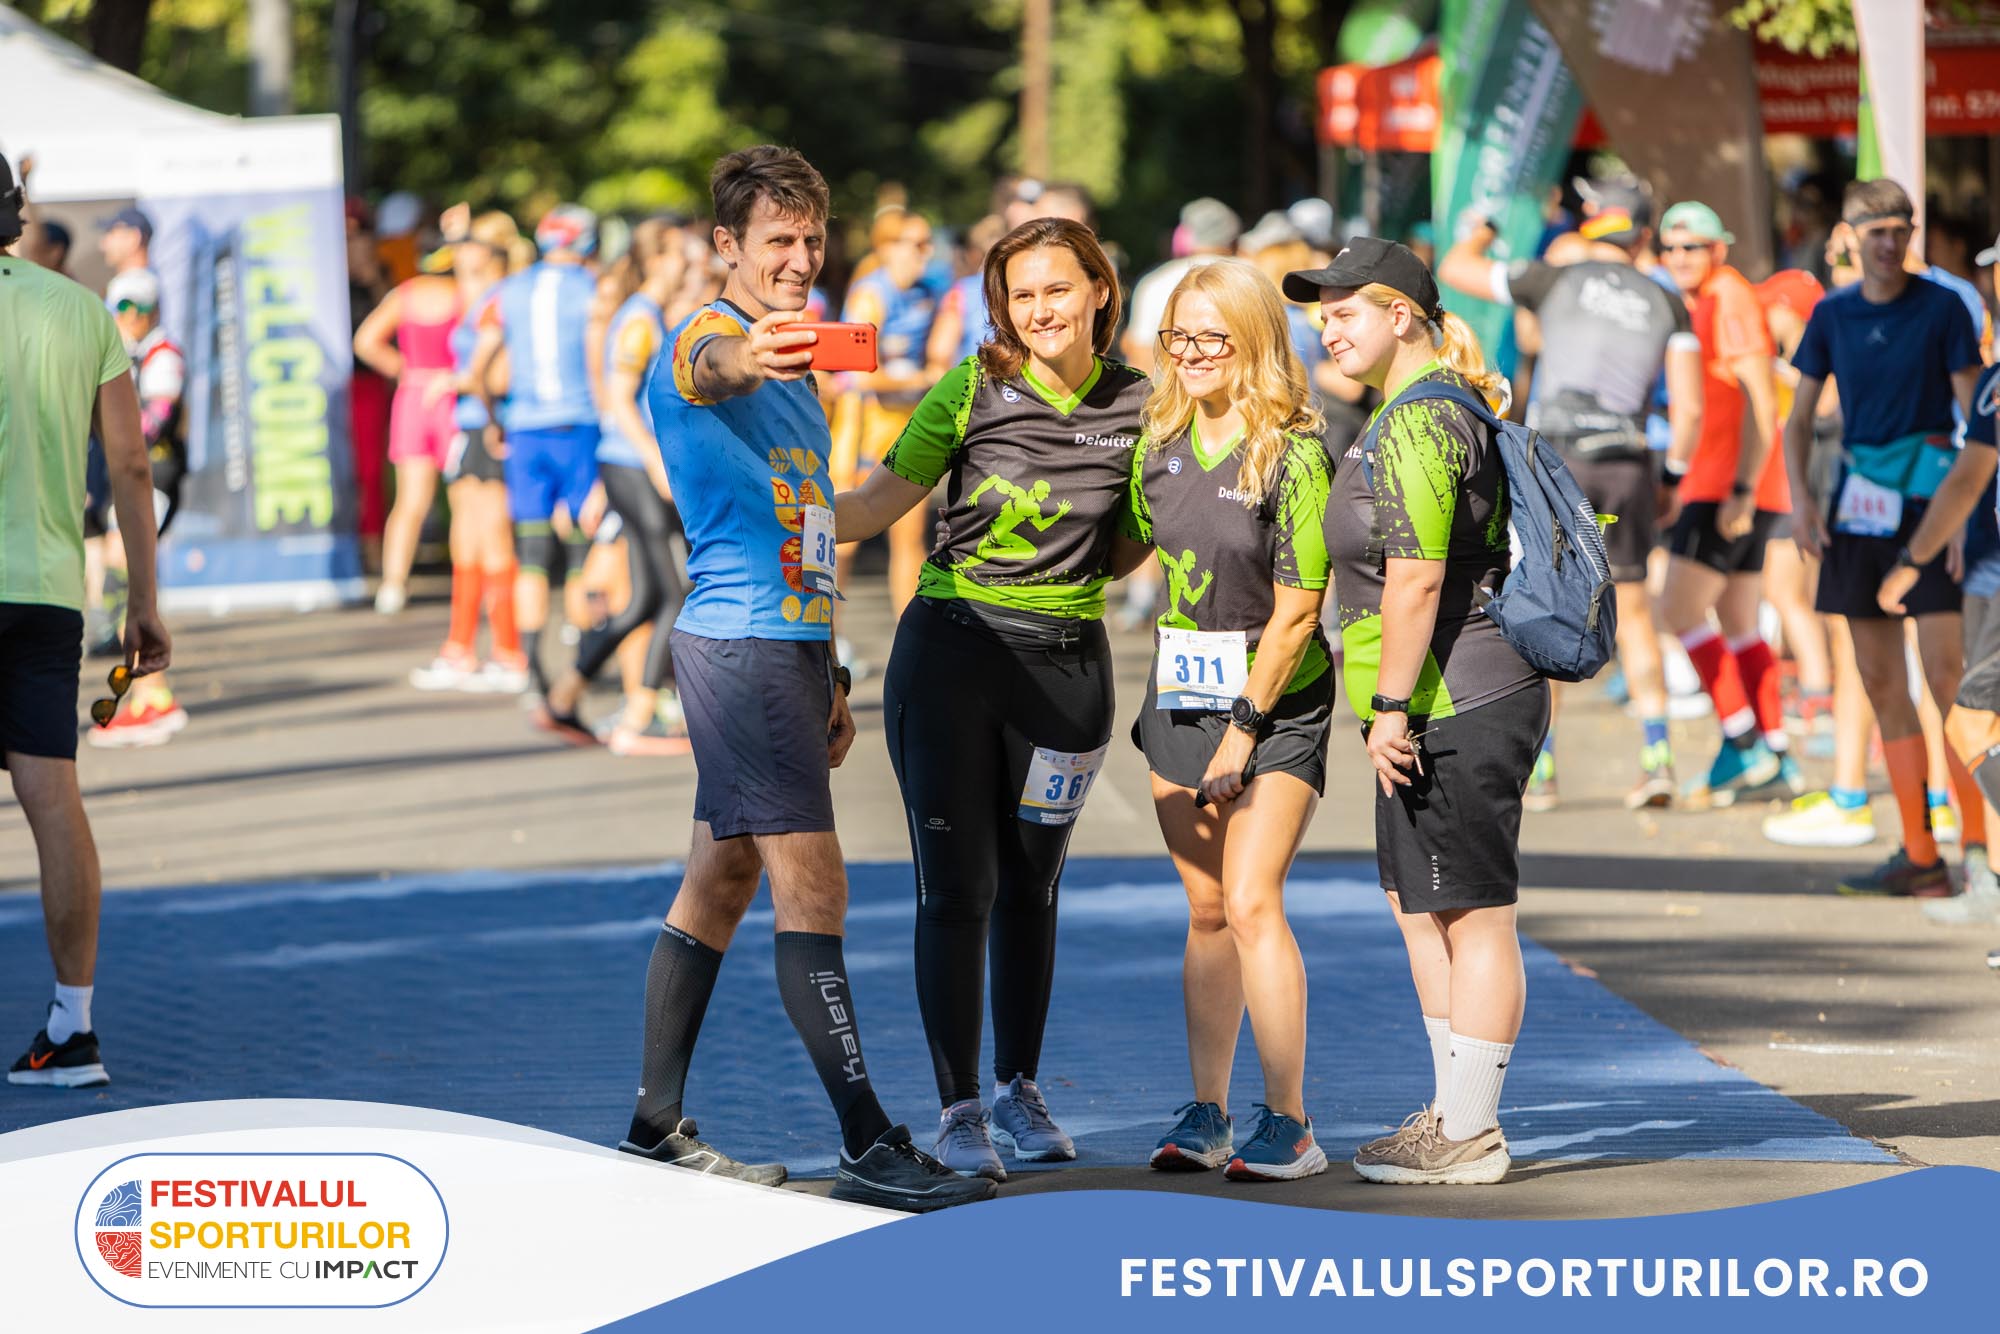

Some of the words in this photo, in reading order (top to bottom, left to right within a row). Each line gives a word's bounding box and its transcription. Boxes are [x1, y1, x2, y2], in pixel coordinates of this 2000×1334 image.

[242, 205, 333, 531] WELCOME
[1074, 433, 1135, 448] Deloitte
[1175, 654, 1225, 685] 371
[1430, 855, 1440, 891] KIPSTA
[809, 970, 866, 1083] kalenji
